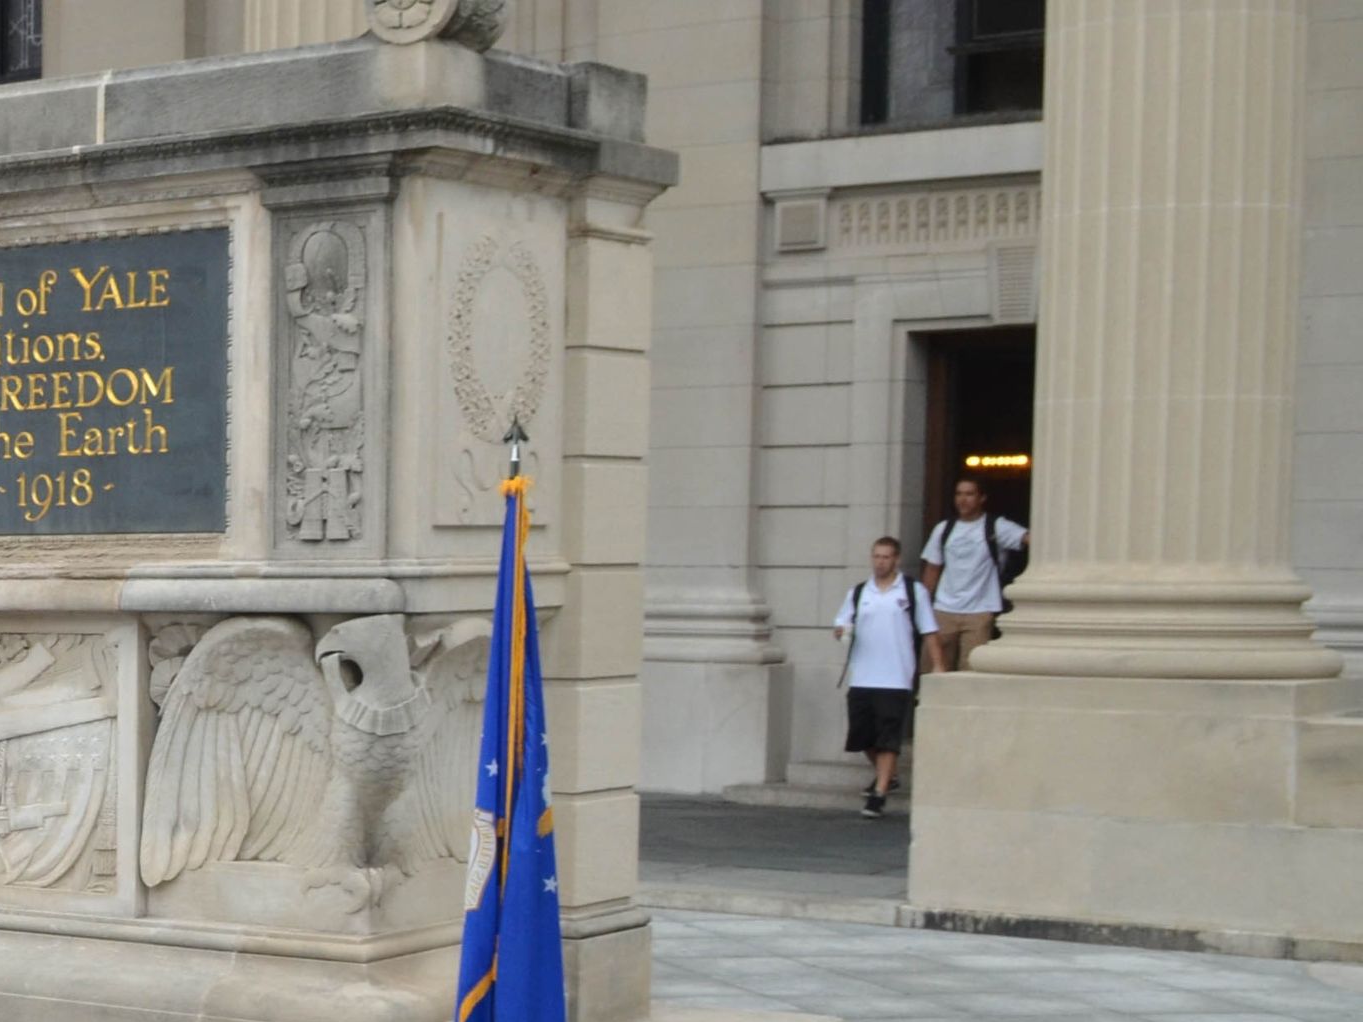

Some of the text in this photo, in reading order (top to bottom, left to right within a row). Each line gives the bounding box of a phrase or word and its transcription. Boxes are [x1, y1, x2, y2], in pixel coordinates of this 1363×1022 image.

[16, 270, 57, 316] of
[70, 265, 169, 311] YALE
[58, 408, 168, 457] Earth
